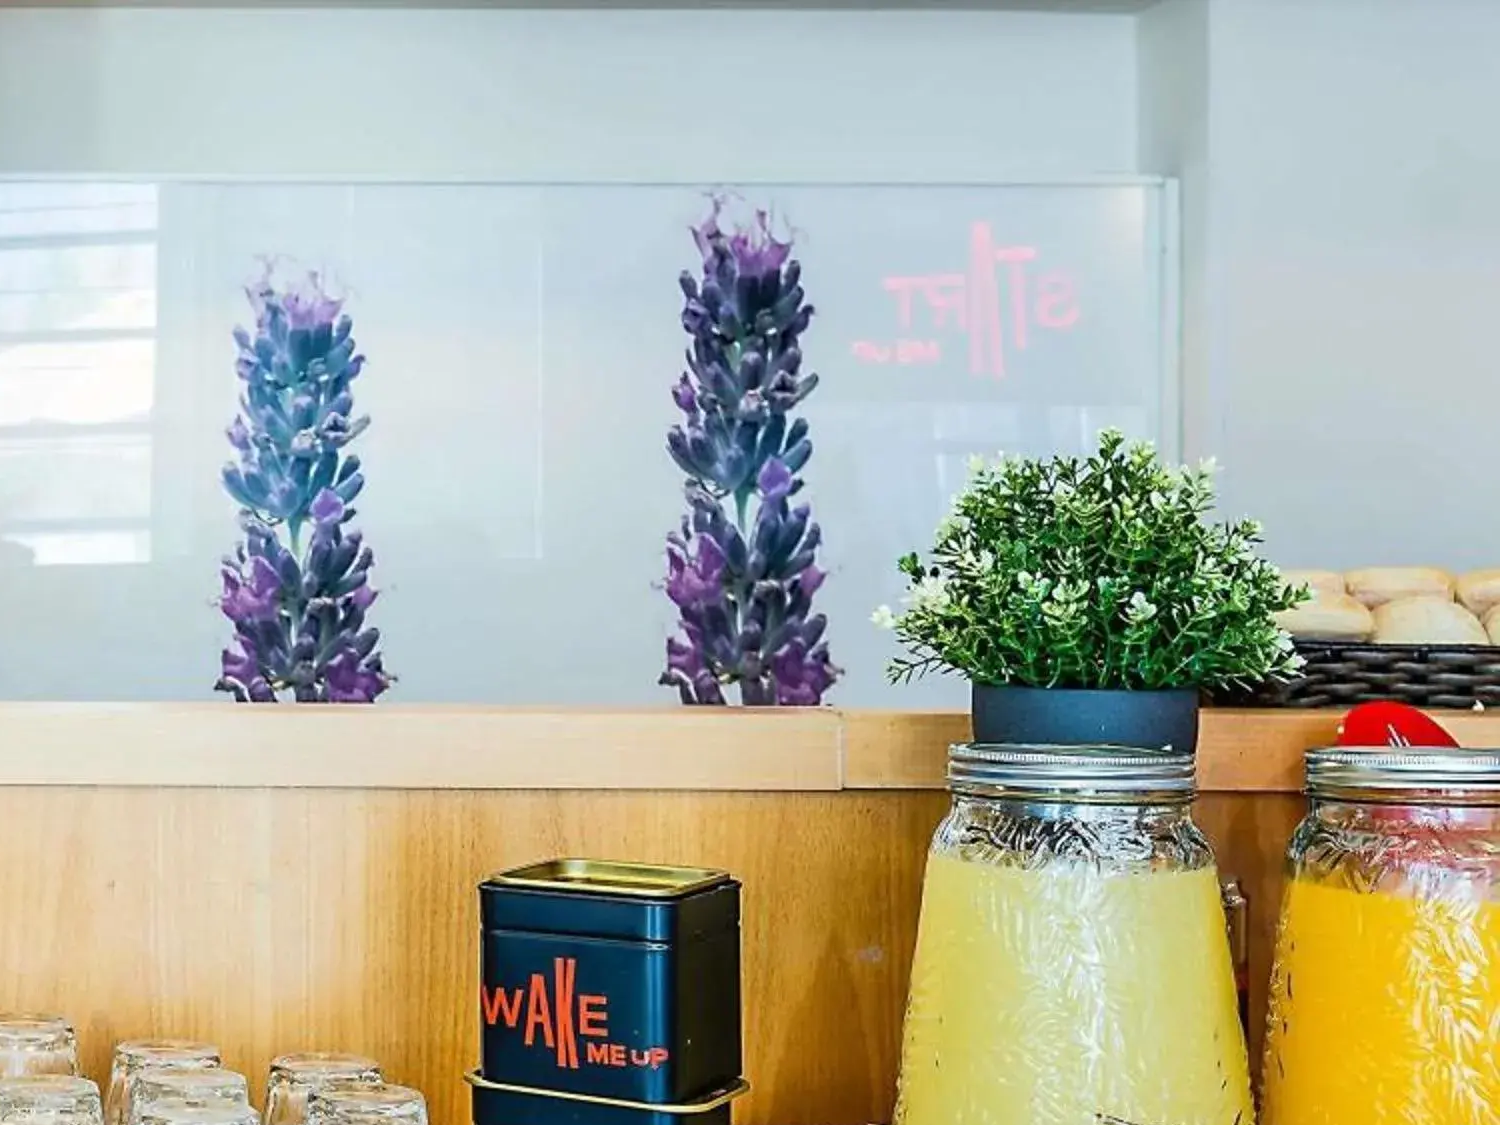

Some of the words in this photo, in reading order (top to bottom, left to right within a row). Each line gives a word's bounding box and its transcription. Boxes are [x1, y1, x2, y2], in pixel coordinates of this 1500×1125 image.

[481, 957, 609, 1069] WAKE
[587, 1042, 627, 1067] ME
[630, 1046, 670, 1070] UP
